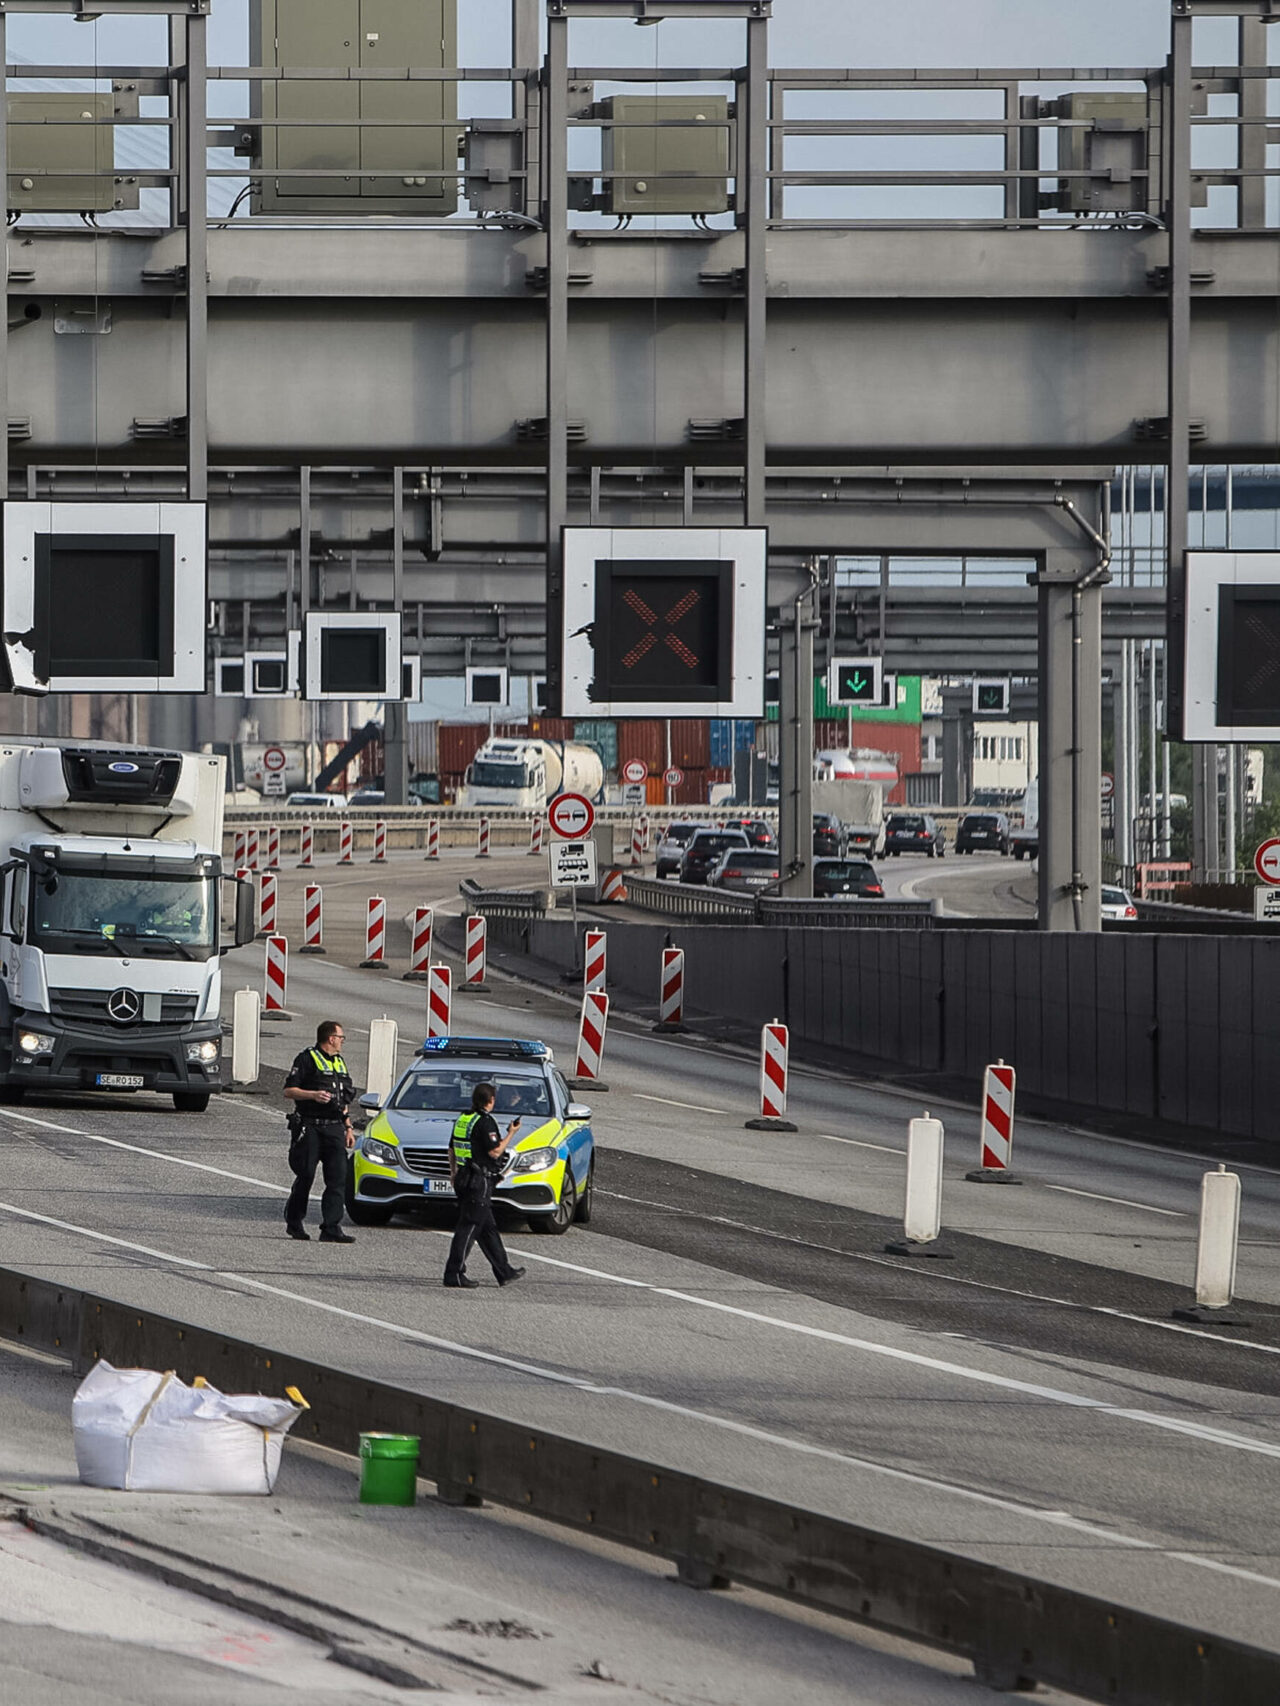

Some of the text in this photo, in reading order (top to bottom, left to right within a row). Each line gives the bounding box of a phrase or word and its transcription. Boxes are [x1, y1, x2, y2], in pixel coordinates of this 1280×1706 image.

[101, 1076, 111, 1084] SE
[128, 1078, 142, 1086] 152
[434, 1181, 447, 1191] HH
